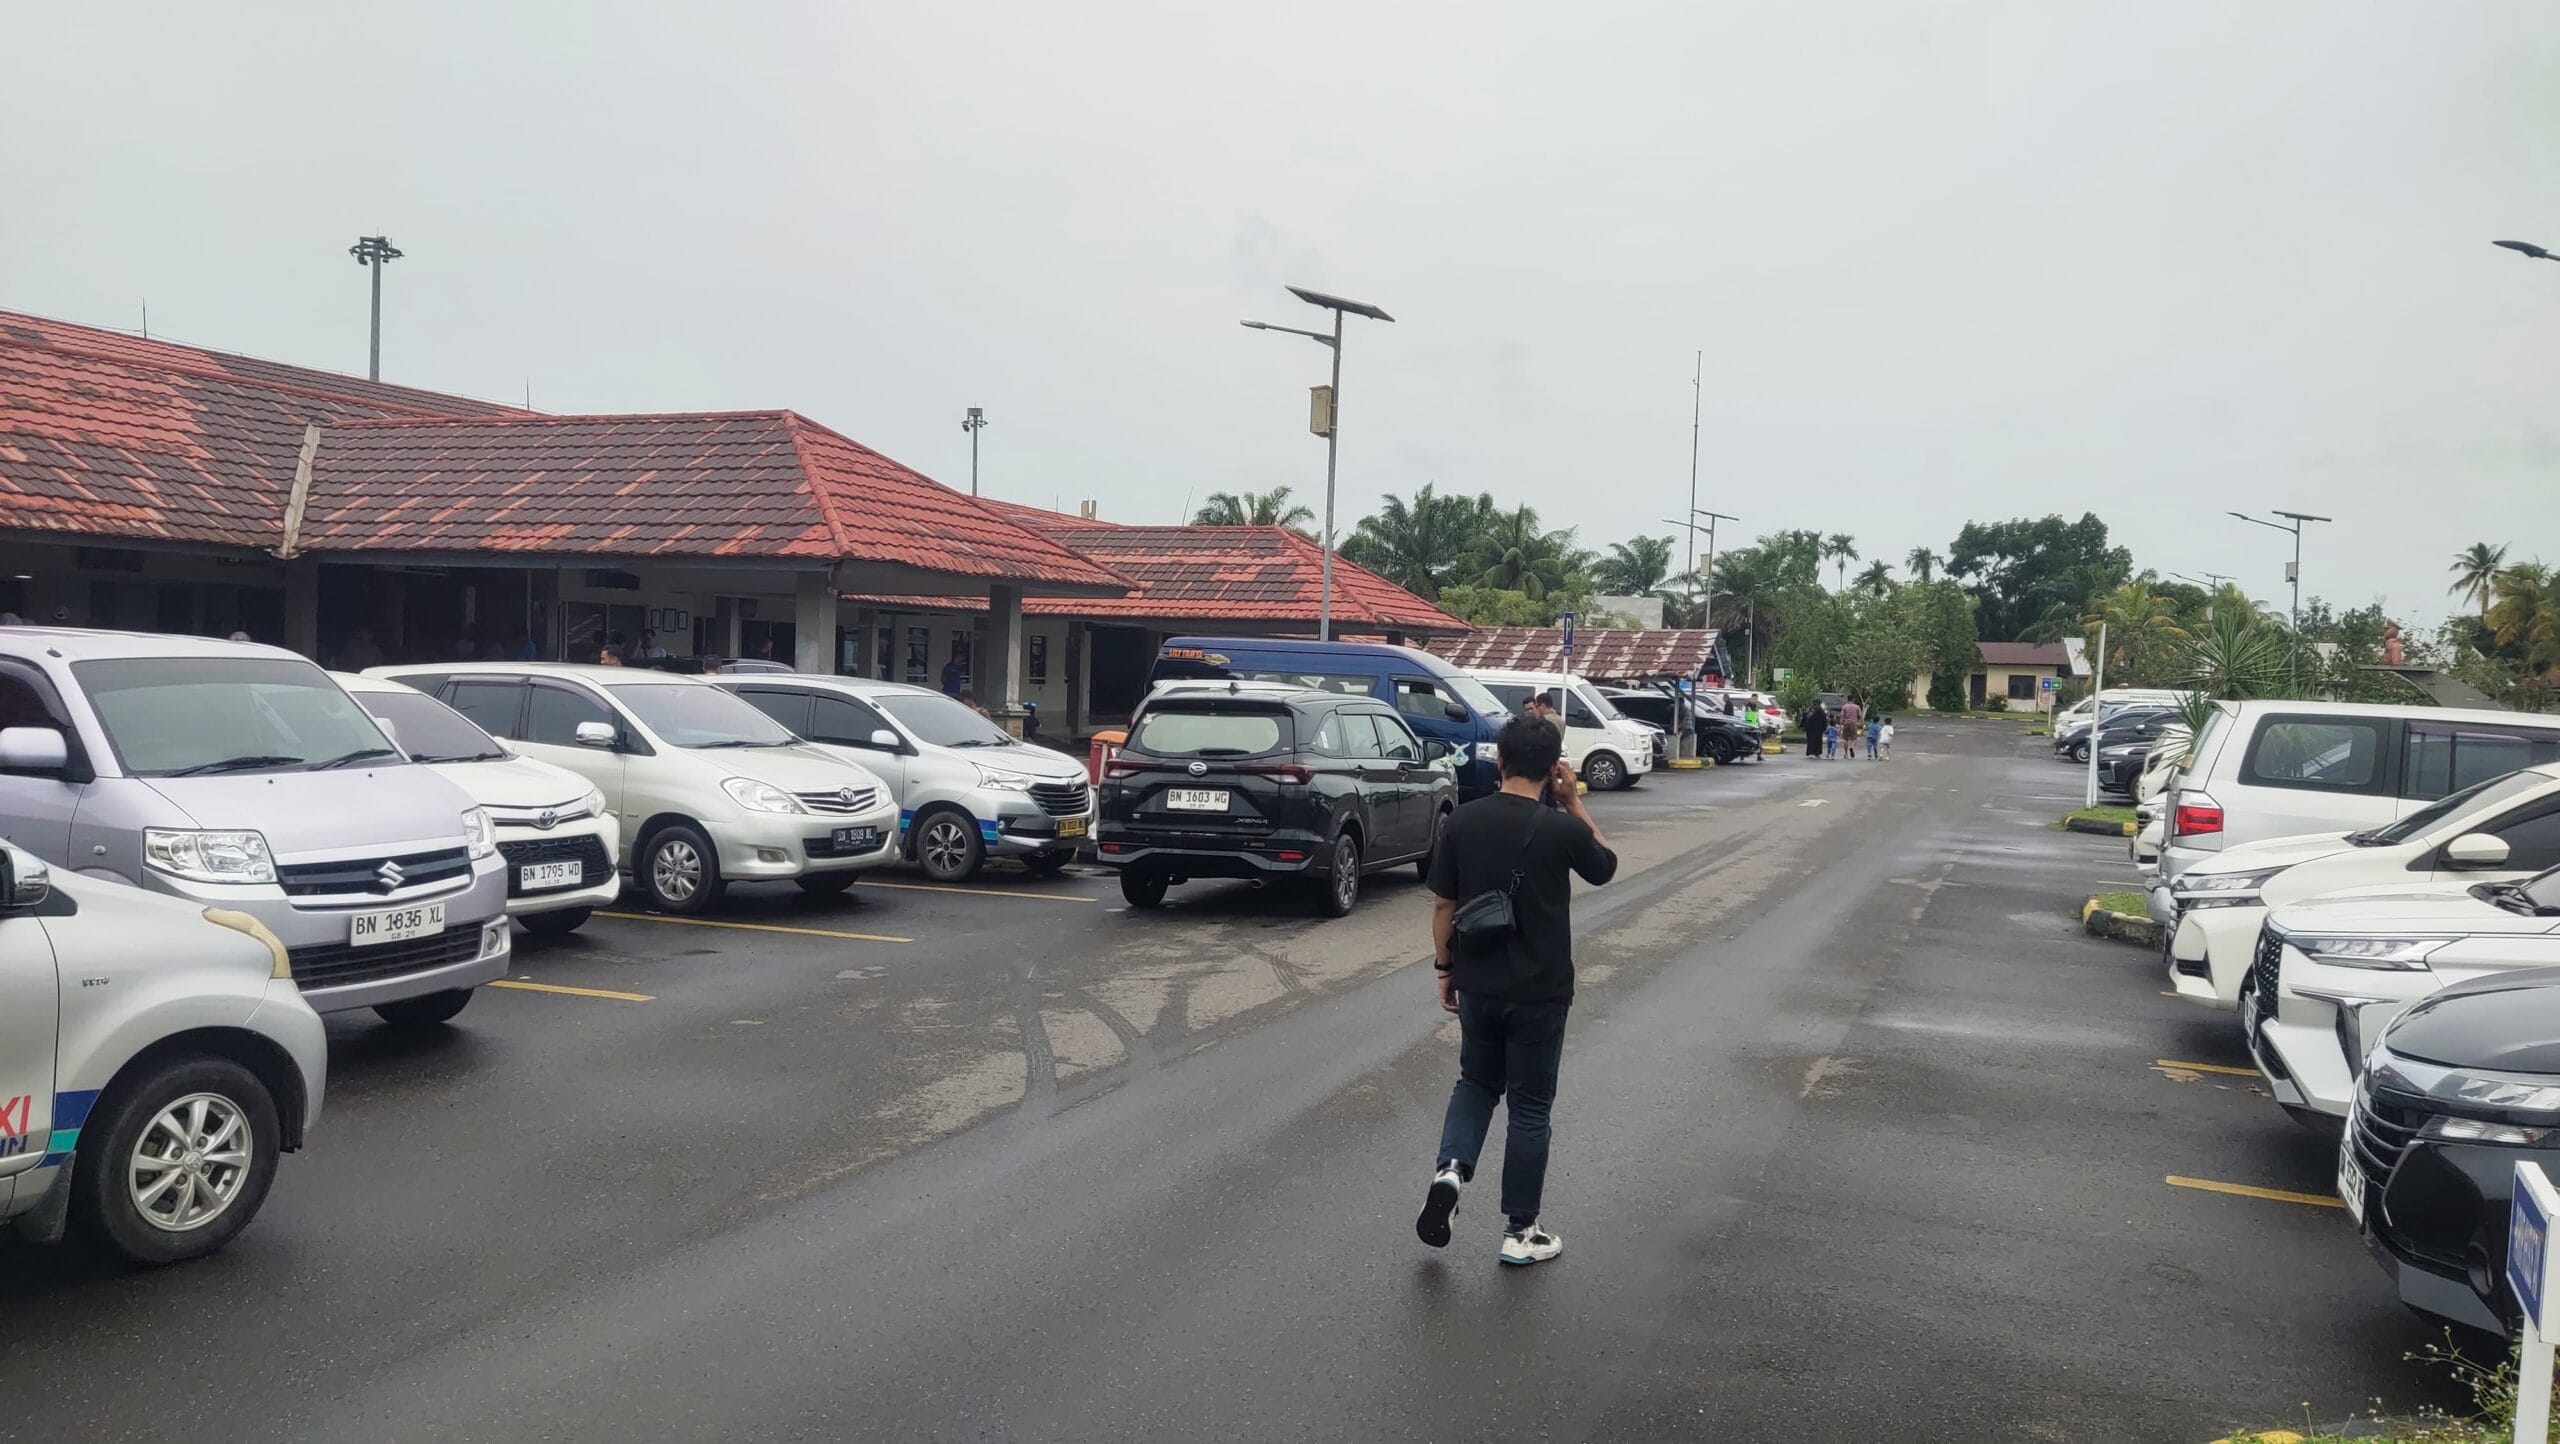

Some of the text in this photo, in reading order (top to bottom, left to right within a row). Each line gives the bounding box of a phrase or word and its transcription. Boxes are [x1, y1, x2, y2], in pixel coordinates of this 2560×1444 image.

[1565, 617, 1572, 641] P
[1169, 790, 1183, 802] BN
[1186, 791, 1211, 803] 1603
[522, 867, 536, 881] BN
[540, 864, 564, 879] 1795
[355, 905, 442, 935] BN 1835 XL
